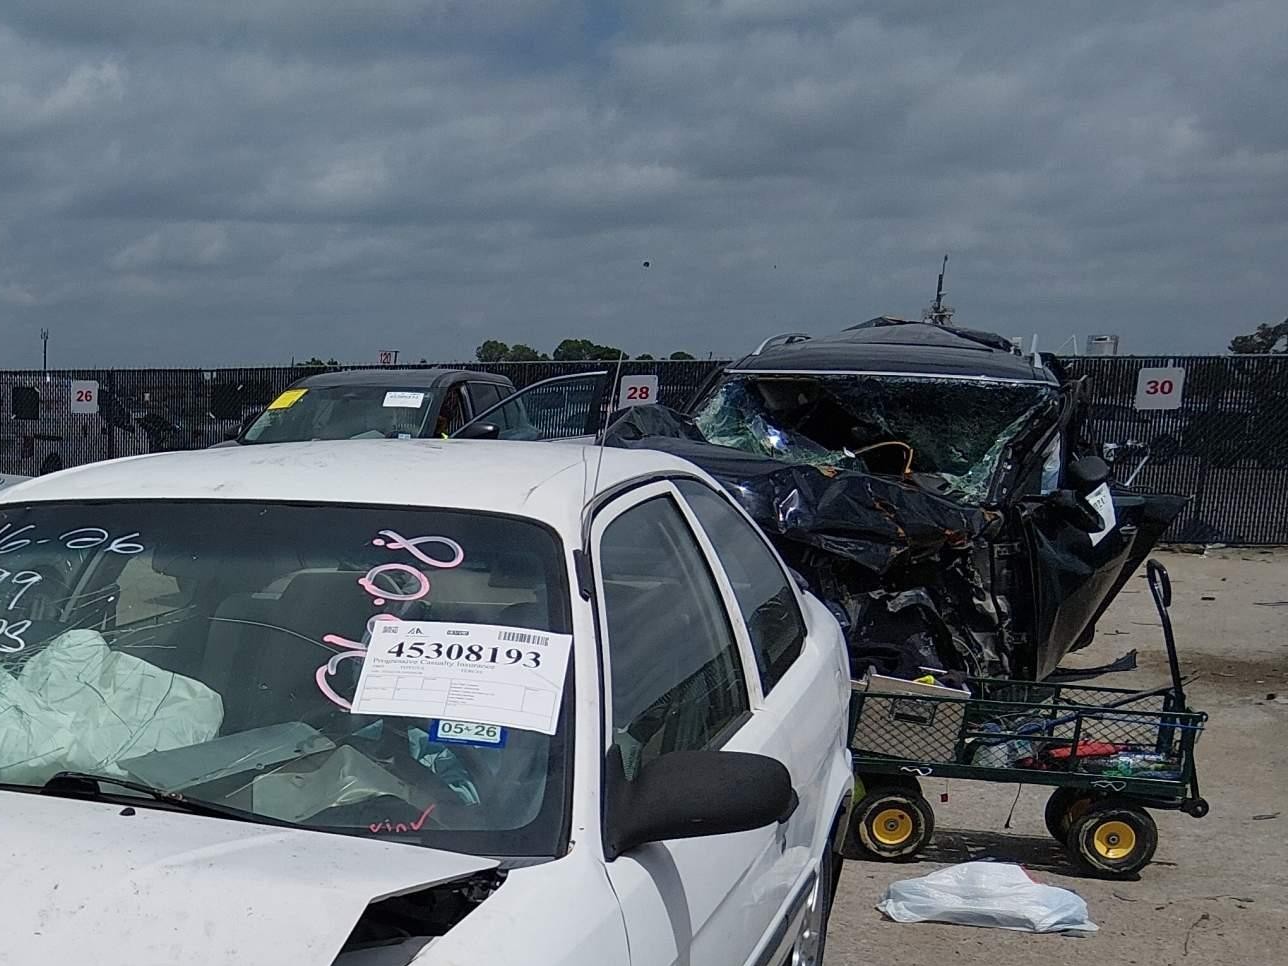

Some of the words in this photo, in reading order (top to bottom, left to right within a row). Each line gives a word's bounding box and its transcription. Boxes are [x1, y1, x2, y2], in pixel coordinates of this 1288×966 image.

[627, 386, 649, 400] 28
[1145, 380, 1173, 395] 30
[76, 390, 92, 402] 26
[387, 641, 542, 669] 45308193
[420, 659, 455, 668] Casualty
